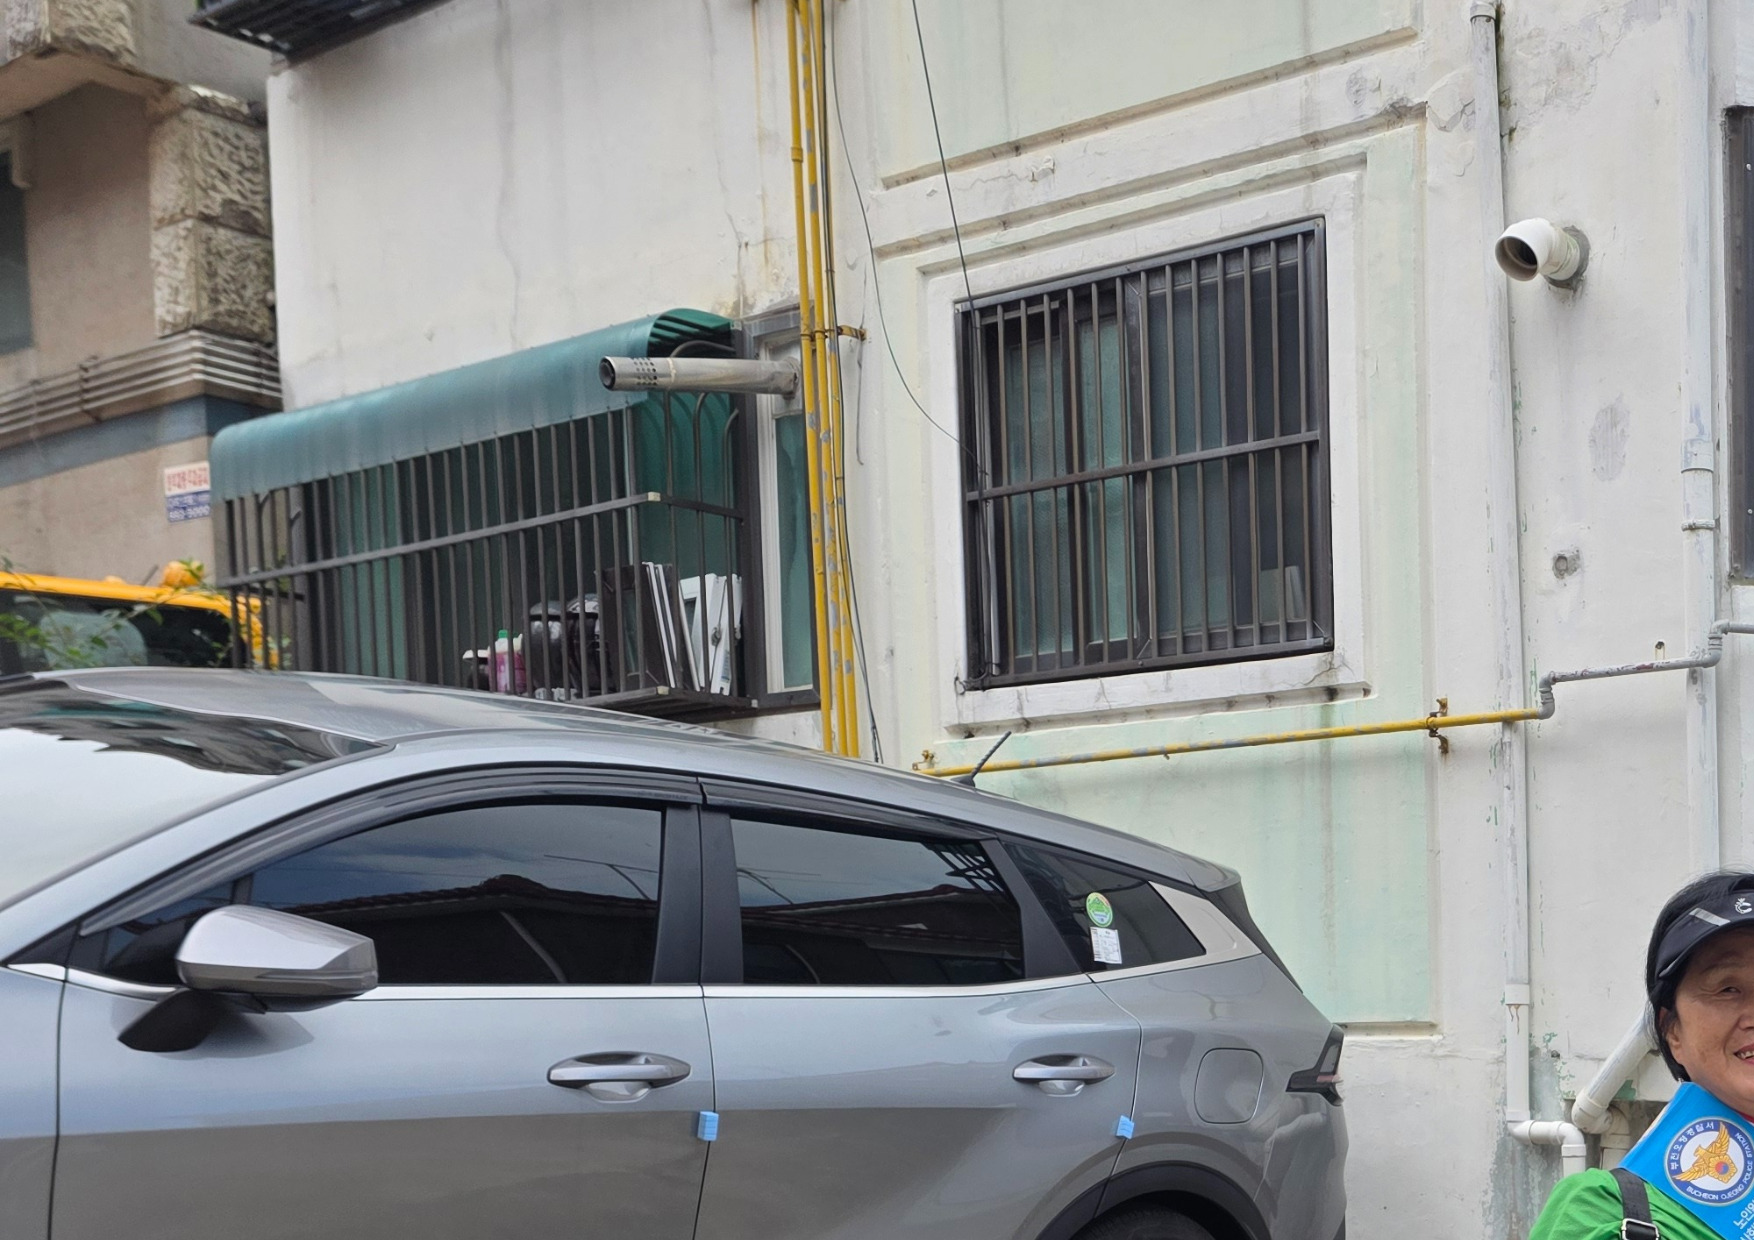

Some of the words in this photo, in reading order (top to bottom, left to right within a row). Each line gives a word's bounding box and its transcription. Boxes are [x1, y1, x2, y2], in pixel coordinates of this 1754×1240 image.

[1734, 1132, 1753, 1159] STATION
[1742, 1160, 1754, 1184] POLICE
[1686, 1185, 1719, 1201] BUCHEON
[1720, 1183, 1745, 1200] OJEONG
